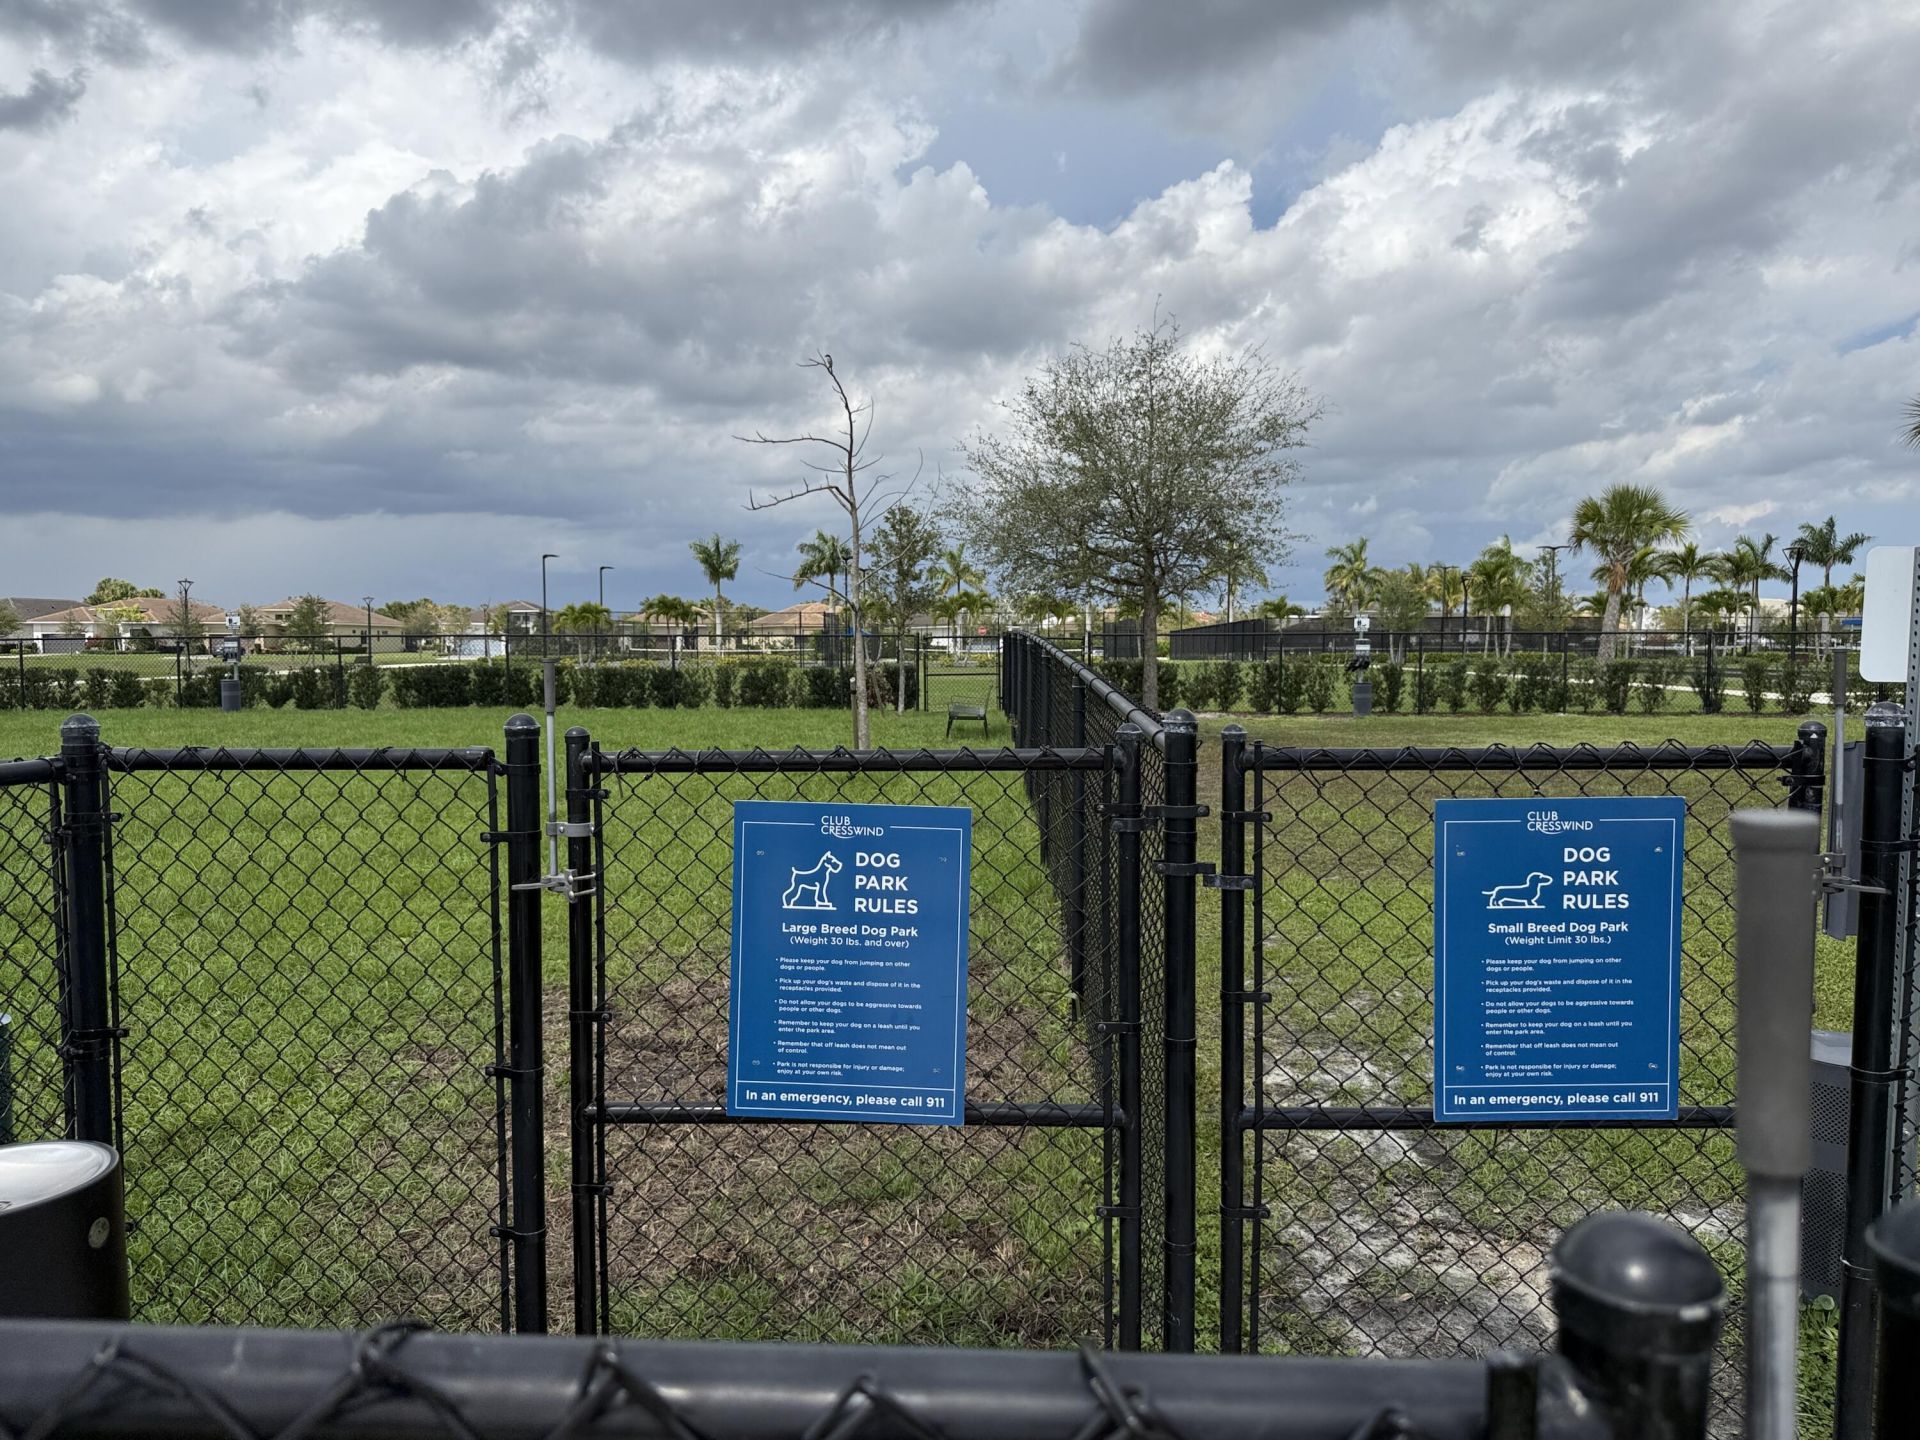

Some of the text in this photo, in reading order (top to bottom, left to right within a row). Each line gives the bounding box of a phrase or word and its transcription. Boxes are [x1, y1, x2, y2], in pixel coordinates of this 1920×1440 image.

[820, 815, 851, 826] CLUB
[1527, 811, 1558, 821] CLUB
[820, 824, 884, 840] CRESSWIND
[1526, 820, 1593, 834] CRESSWIND
[855, 852, 900, 868] DOG
[1563, 847, 1610, 862] DOG
[855, 874, 908, 891] PARK
[1563, 870, 1619, 886] PARK
[854, 897, 918, 914] RULES
[1562, 893, 1630, 909] RULES
[782, 922, 918, 937] Large Breed Dog Park
[1488, 921, 1628, 934] Small Breed Dog Park
[789, 935, 910, 948] (Weight 30 lbs. and over)
[1504, 935, 1612, 946] (Weight Limit 30 lbs.)
[746, 1089, 944, 1108] In an emergency, please call 911
[1454, 1092, 1658, 1106] In an emergency, please call 911
